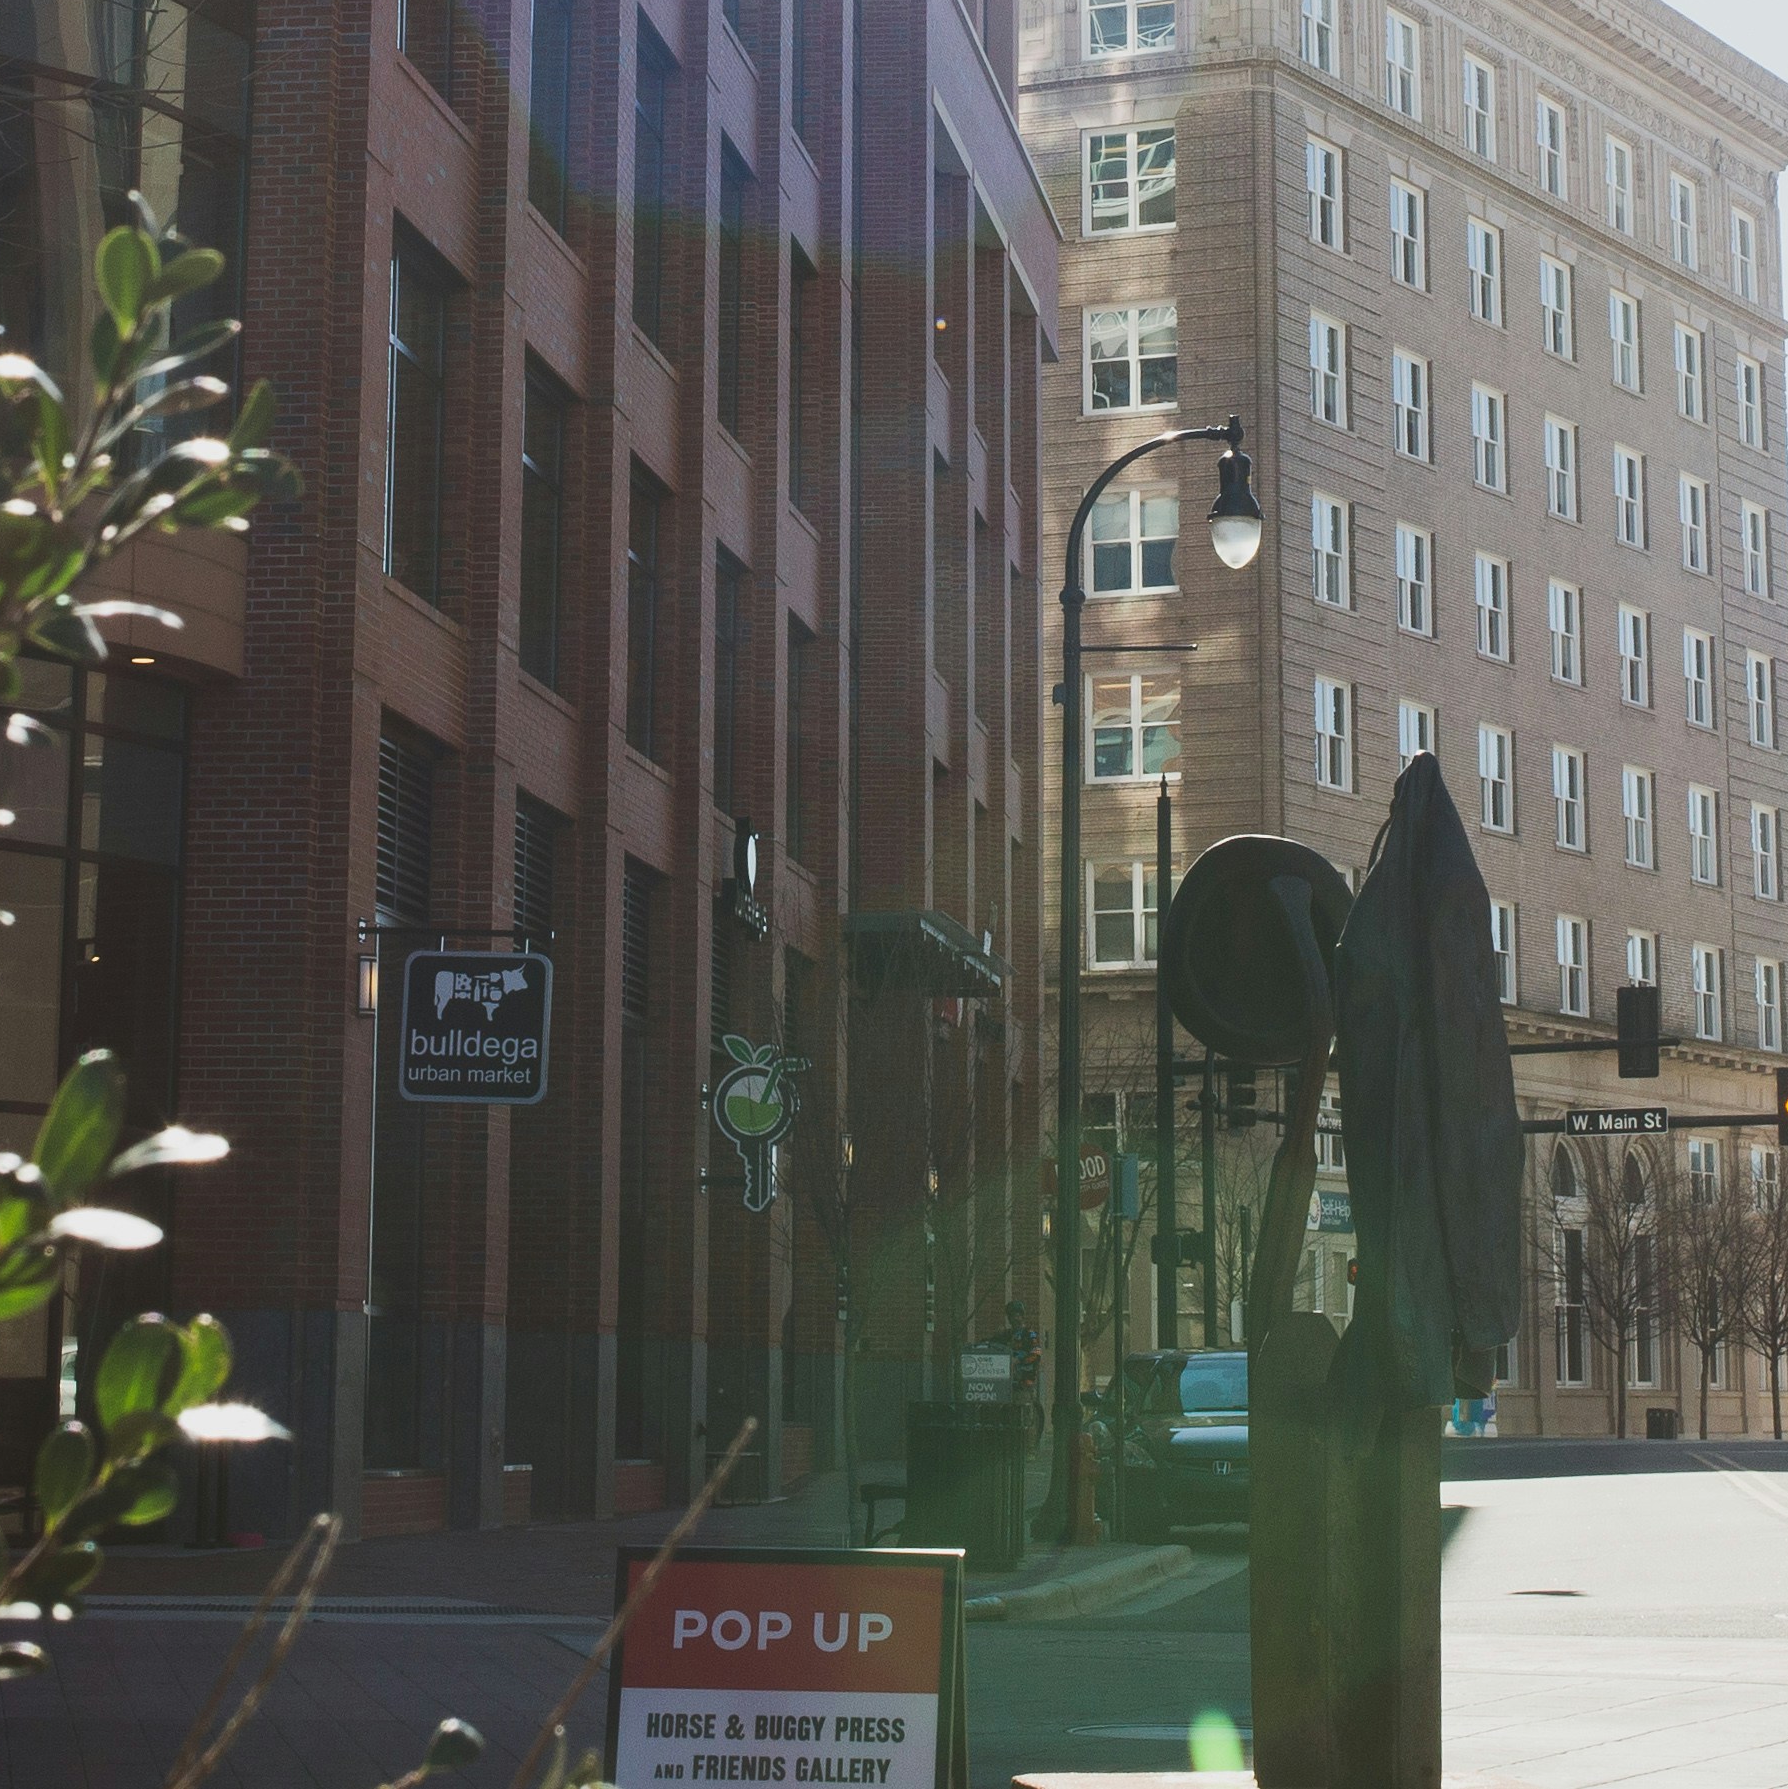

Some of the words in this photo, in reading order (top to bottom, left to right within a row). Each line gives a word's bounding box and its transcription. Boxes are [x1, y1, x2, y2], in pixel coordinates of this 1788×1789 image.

[411, 1028, 538, 1065] bulldega
[408, 1064, 461, 1082] urban
[467, 1066, 531, 1084] market
[1572, 1114, 1593, 1131] W.
[1598, 1113, 1638, 1130] Main
[1643, 1112, 1662, 1129] St
[968, 1383, 995, 1392] NOW
[672, 1610, 792, 1651] POP
[813, 1612, 893, 1653] UP
[646, 1713, 716, 1739] HORSE
[724, 1715, 745, 1740] &
[755, 1715, 826, 1742] BUGGY
[834, 1717, 905, 1744] PRESS
[654, 1763, 684, 1780] AND
[692, 1755, 786, 1782] FRIENDS
[795, 1757, 892, 1784] GALLERY
